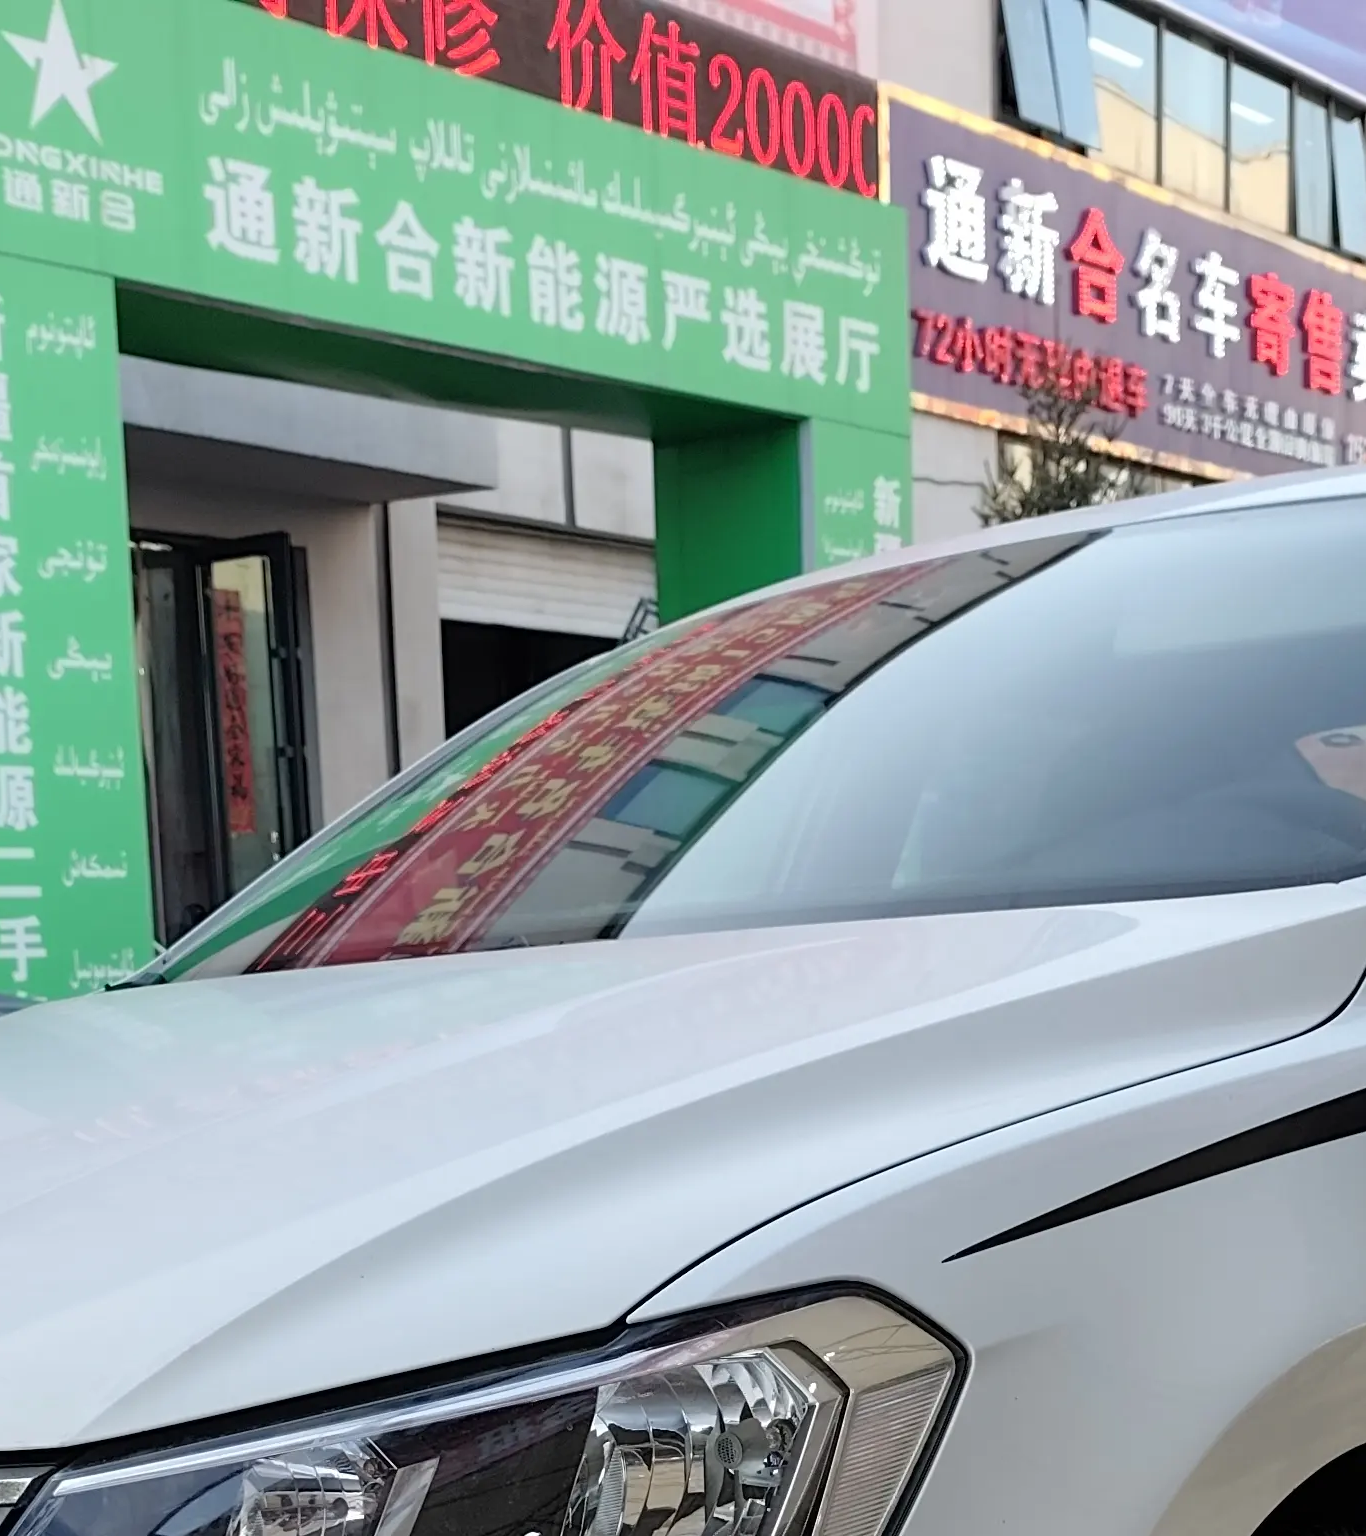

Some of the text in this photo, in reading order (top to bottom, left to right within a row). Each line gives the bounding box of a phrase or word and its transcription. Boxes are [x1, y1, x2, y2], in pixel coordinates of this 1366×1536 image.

[199, 57, 250, 132] زالى
[203, 156, 881, 394] 通新合新能源严选展厅
